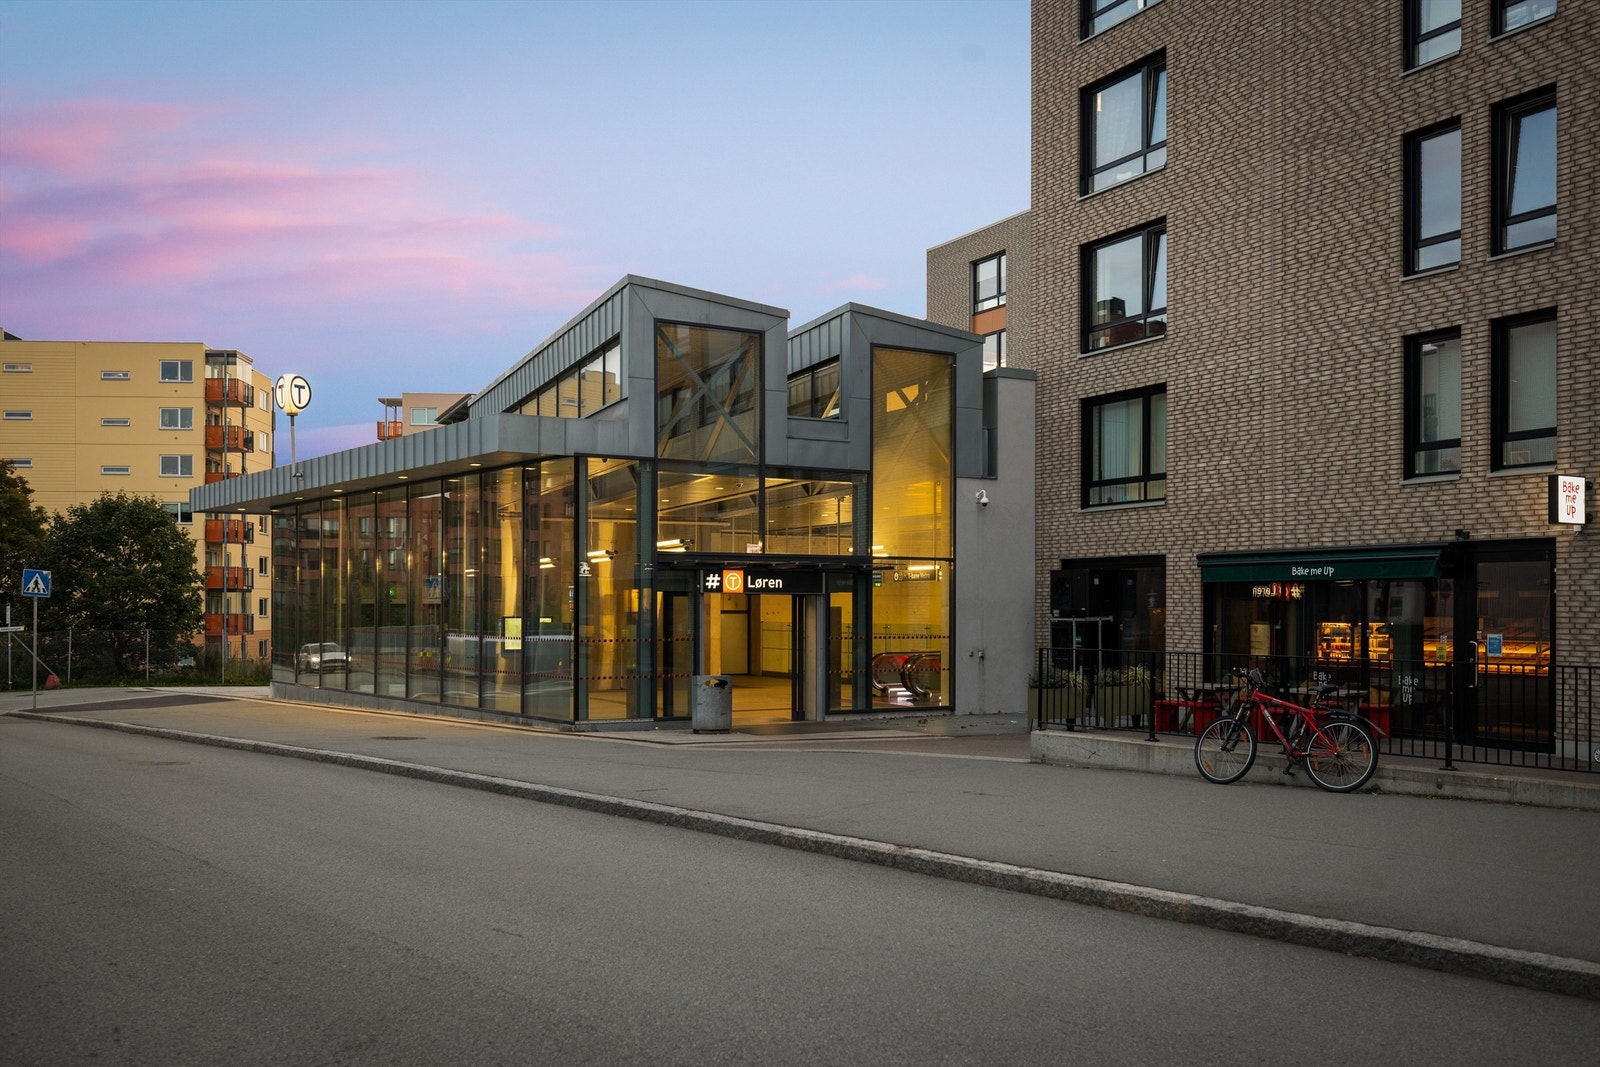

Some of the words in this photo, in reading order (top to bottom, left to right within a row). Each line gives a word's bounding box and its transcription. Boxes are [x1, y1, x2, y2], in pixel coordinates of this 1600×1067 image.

[294, 384, 305, 404] T
[1563, 481, 1580, 494] Bake
[1566, 494, 1576, 503] me
[1292, 567, 1309, 575] Bake
[747, 575, 783, 588] Løren
